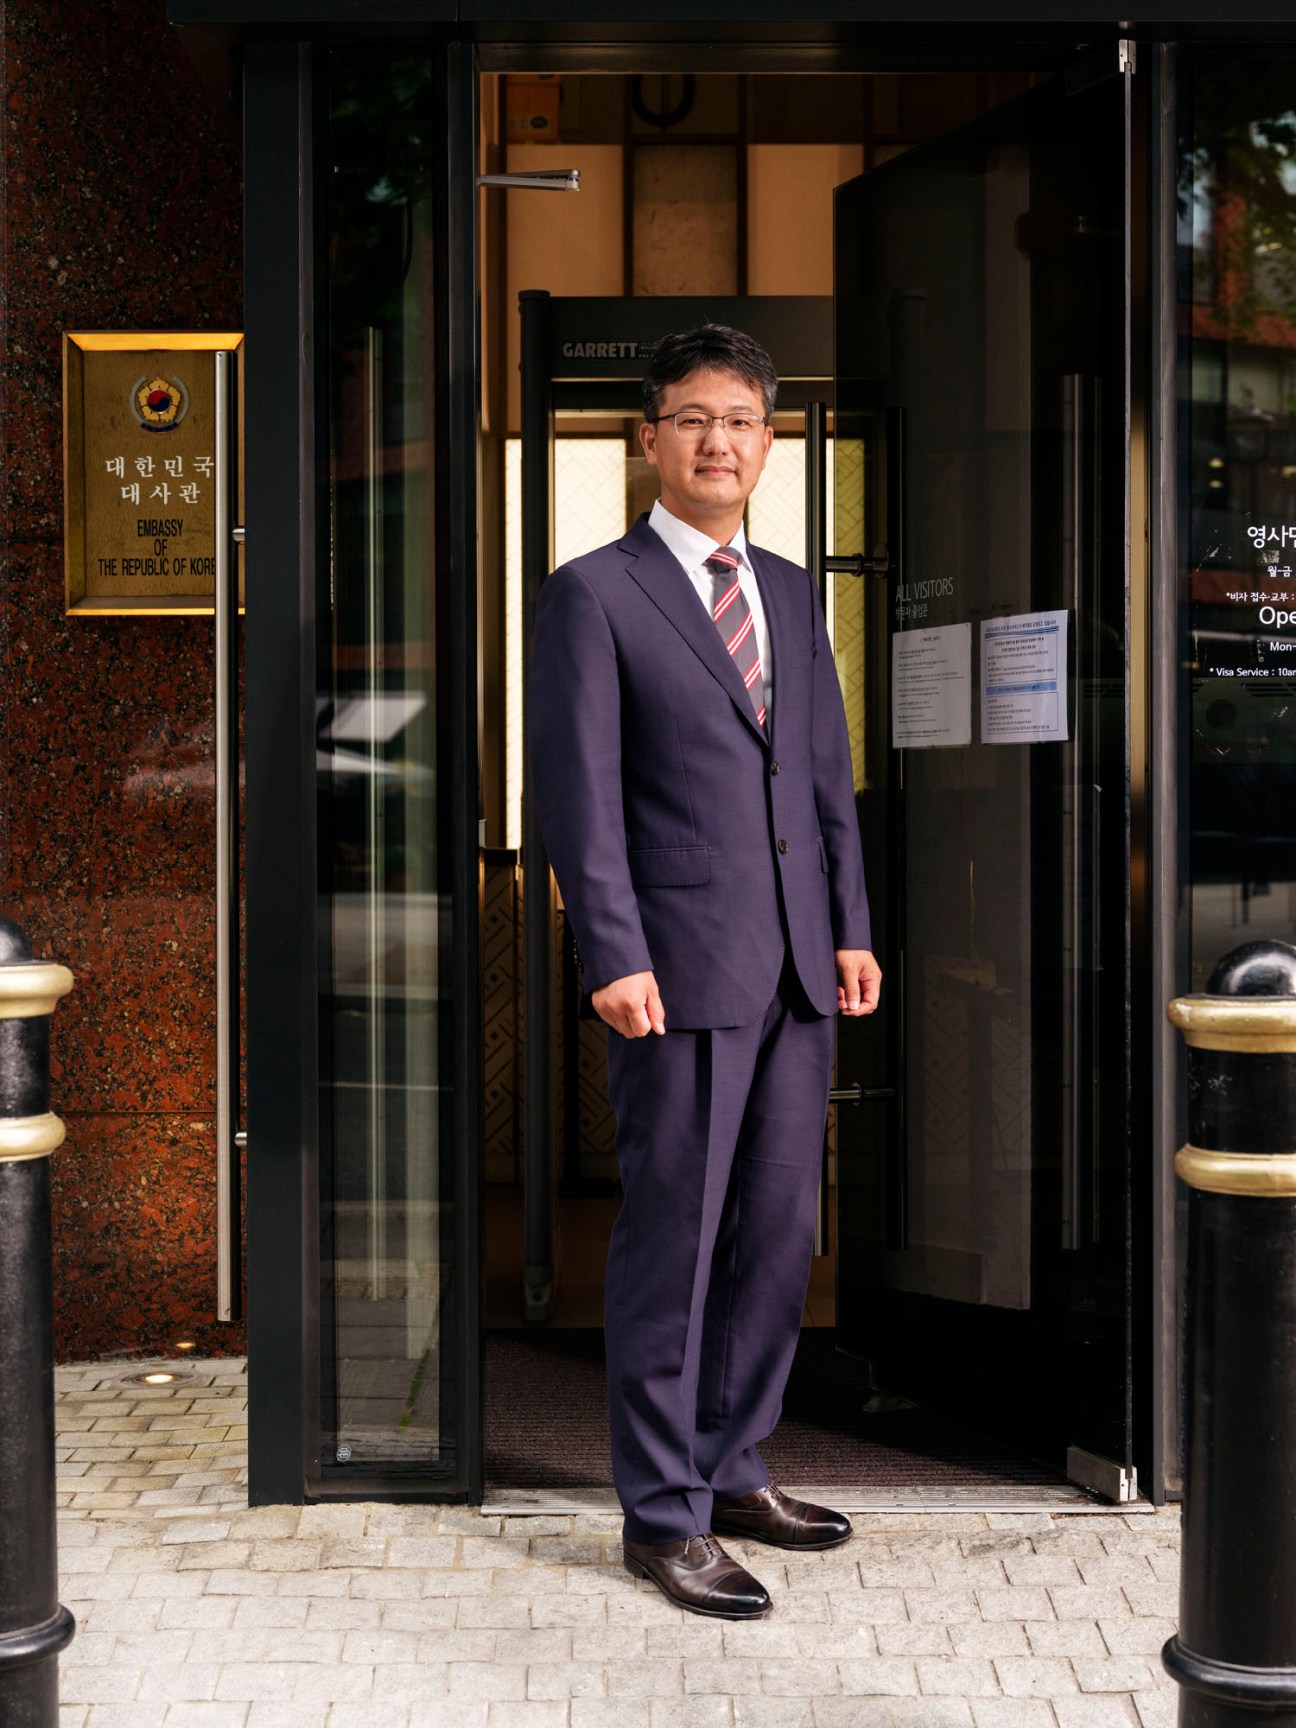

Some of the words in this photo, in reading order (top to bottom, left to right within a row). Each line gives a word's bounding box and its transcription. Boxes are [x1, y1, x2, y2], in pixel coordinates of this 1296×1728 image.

[562, 342, 638, 358] GARRETT
[105, 456, 214, 478] 대한민국
[121, 482, 200, 505] 대사관
[137, 519, 183, 537] EMBASSY
[154, 539, 168, 556] OF
[98, 558, 117, 576] THE
[122, 558, 169, 576] REPUBLIC
[173, 558, 187, 576] OF
[190, 558, 215, 576] KORE
[1267, 565, 1293, 577] 월-금
[895, 584, 911, 602] ALL
[913, 577, 954, 600] VISITORS
[1259, 606, 1296, 629] Ope
[1216, 667, 1235, 677] Visa
[1236, 667, 1269, 677] Service
